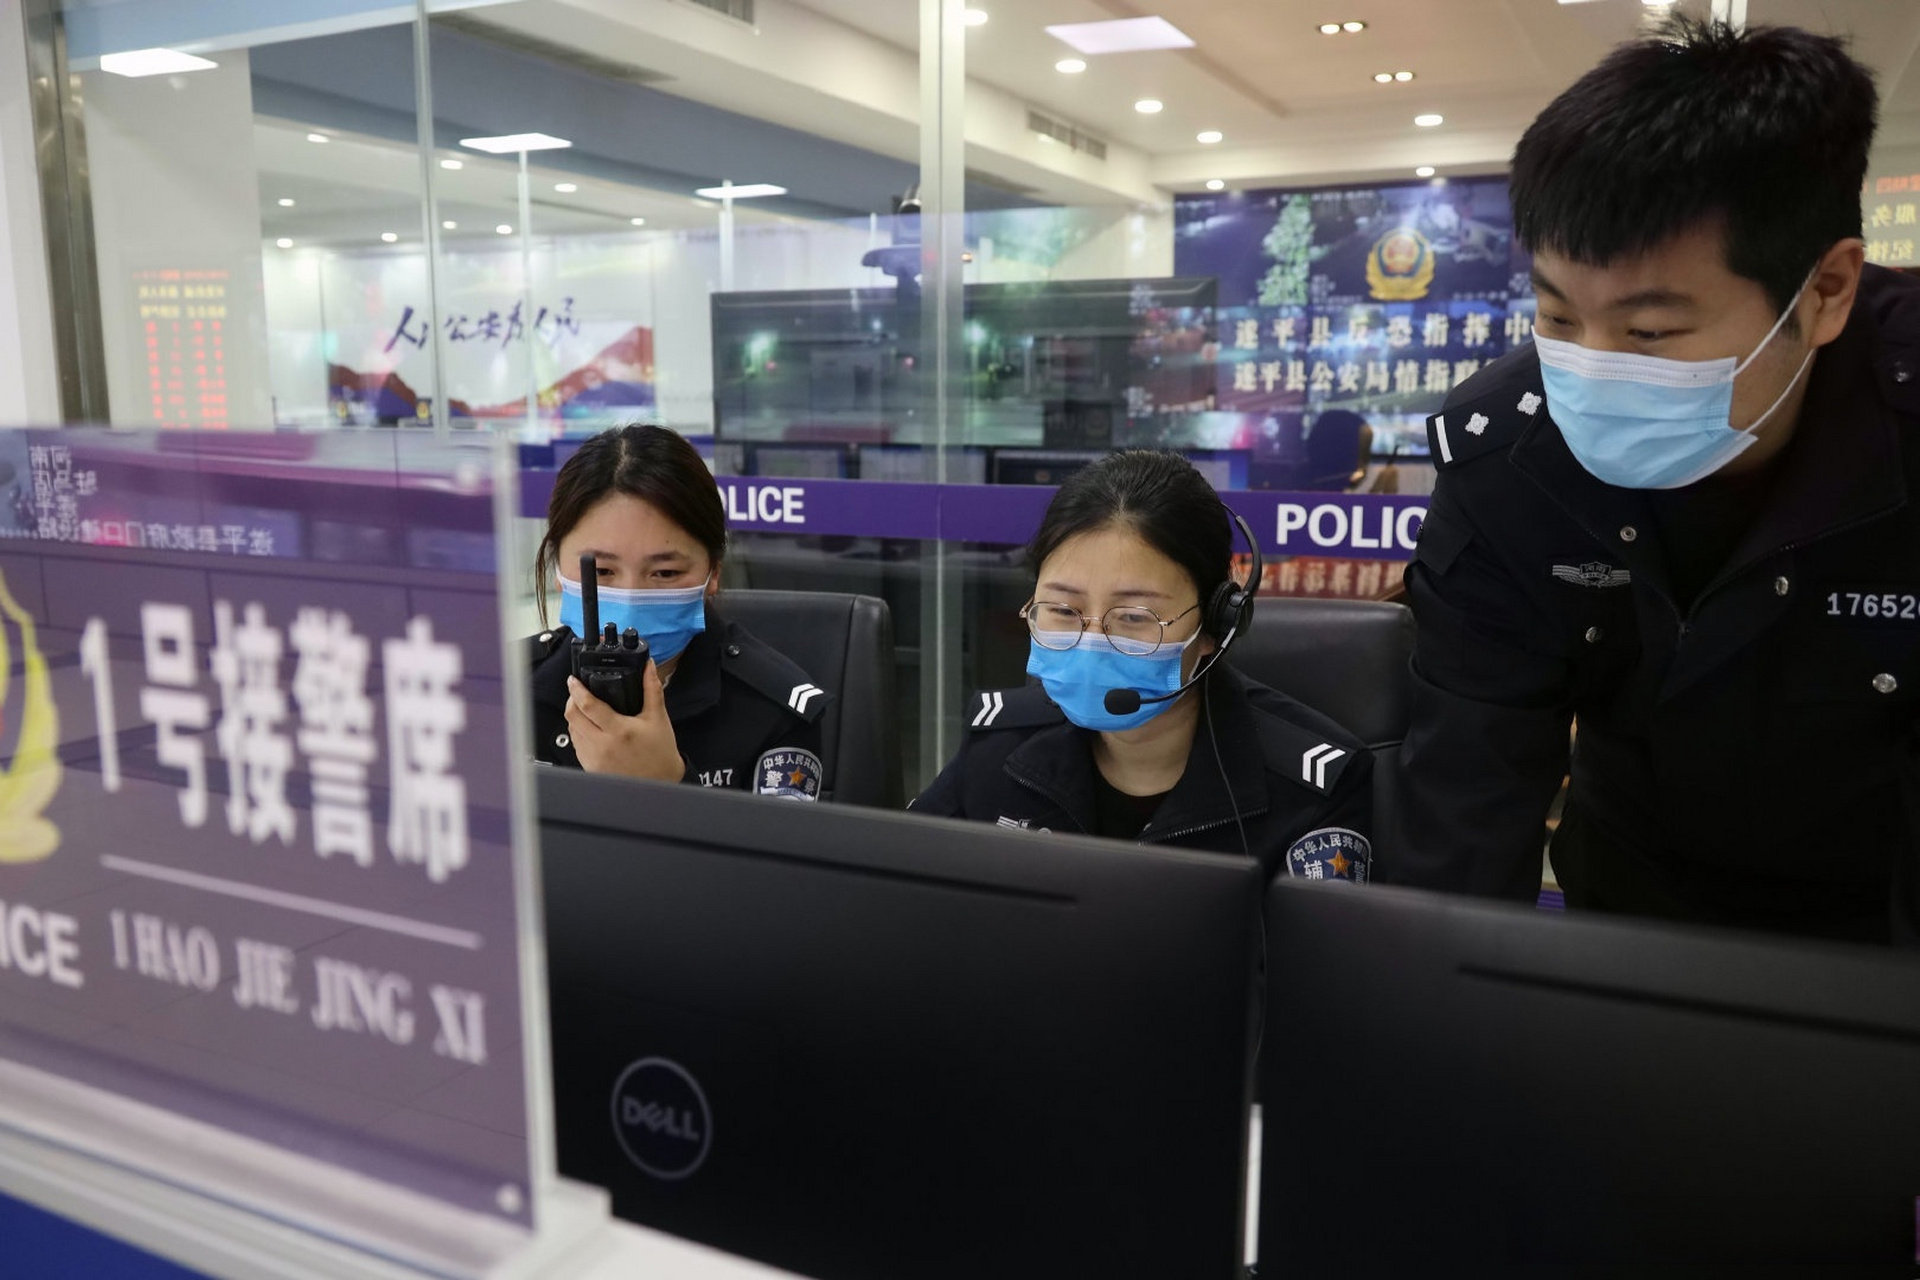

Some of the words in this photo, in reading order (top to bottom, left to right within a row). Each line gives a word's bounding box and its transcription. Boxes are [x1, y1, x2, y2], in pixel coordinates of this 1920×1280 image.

[1276, 503, 1428, 551] POLIC
[1827, 593, 1920, 620] 17652
[79, 599, 470, 884] 1号接警席
[1303, 859, 1324, 880] 辅
[131, 910, 222, 994] HAO
[230, 936, 299, 1017] JIE
[309, 954, 416, 1046] JING
[428, 982, 489, 1068] XI
[622, 1096, 699, 1141] DELL
